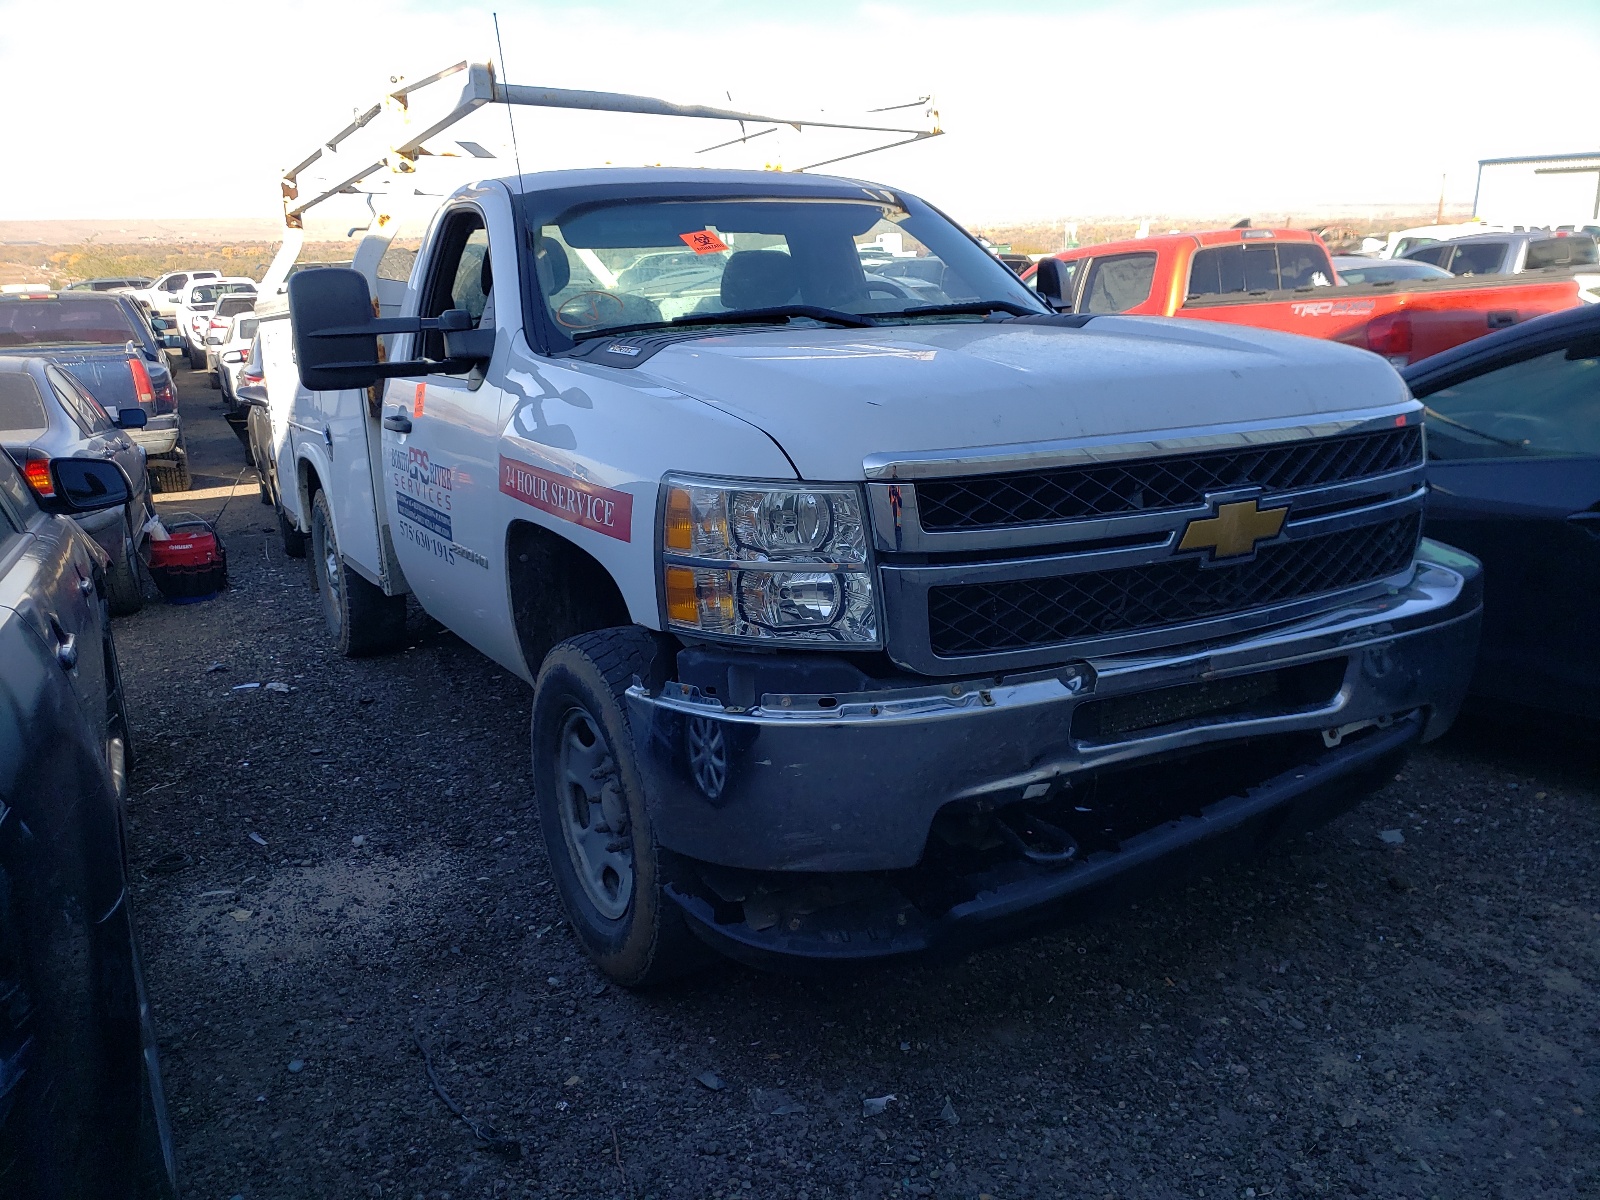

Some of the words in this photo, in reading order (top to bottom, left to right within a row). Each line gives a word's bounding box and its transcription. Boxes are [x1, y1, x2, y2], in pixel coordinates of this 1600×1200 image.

[1291, 302, 1333, 317] TRD
[394, 472, 451, 511] SERVICES
[505, 465, 515, 489] 24
[517, 470, 549, 503] HOUR
[551, 482, 615, 528] SERVICE
